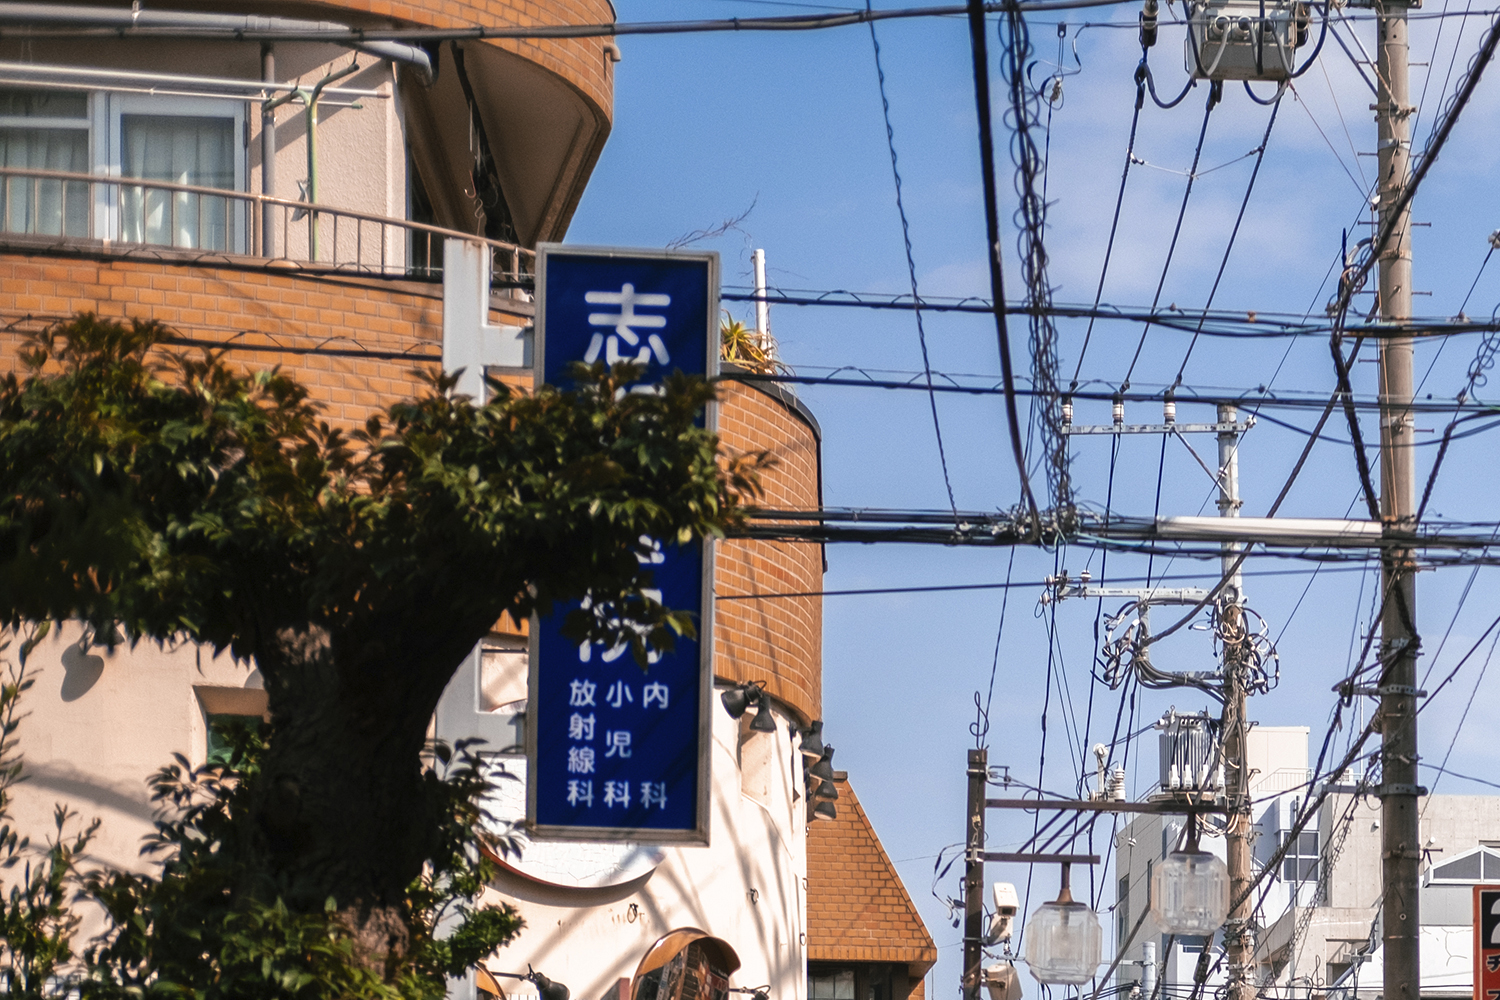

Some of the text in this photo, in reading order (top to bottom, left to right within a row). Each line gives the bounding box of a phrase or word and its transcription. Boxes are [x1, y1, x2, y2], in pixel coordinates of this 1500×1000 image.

[567, 679, 597, 808] 放射線科
[603, 679, 634, 809] 小児科
[640, 681, 669, 810] 内科
